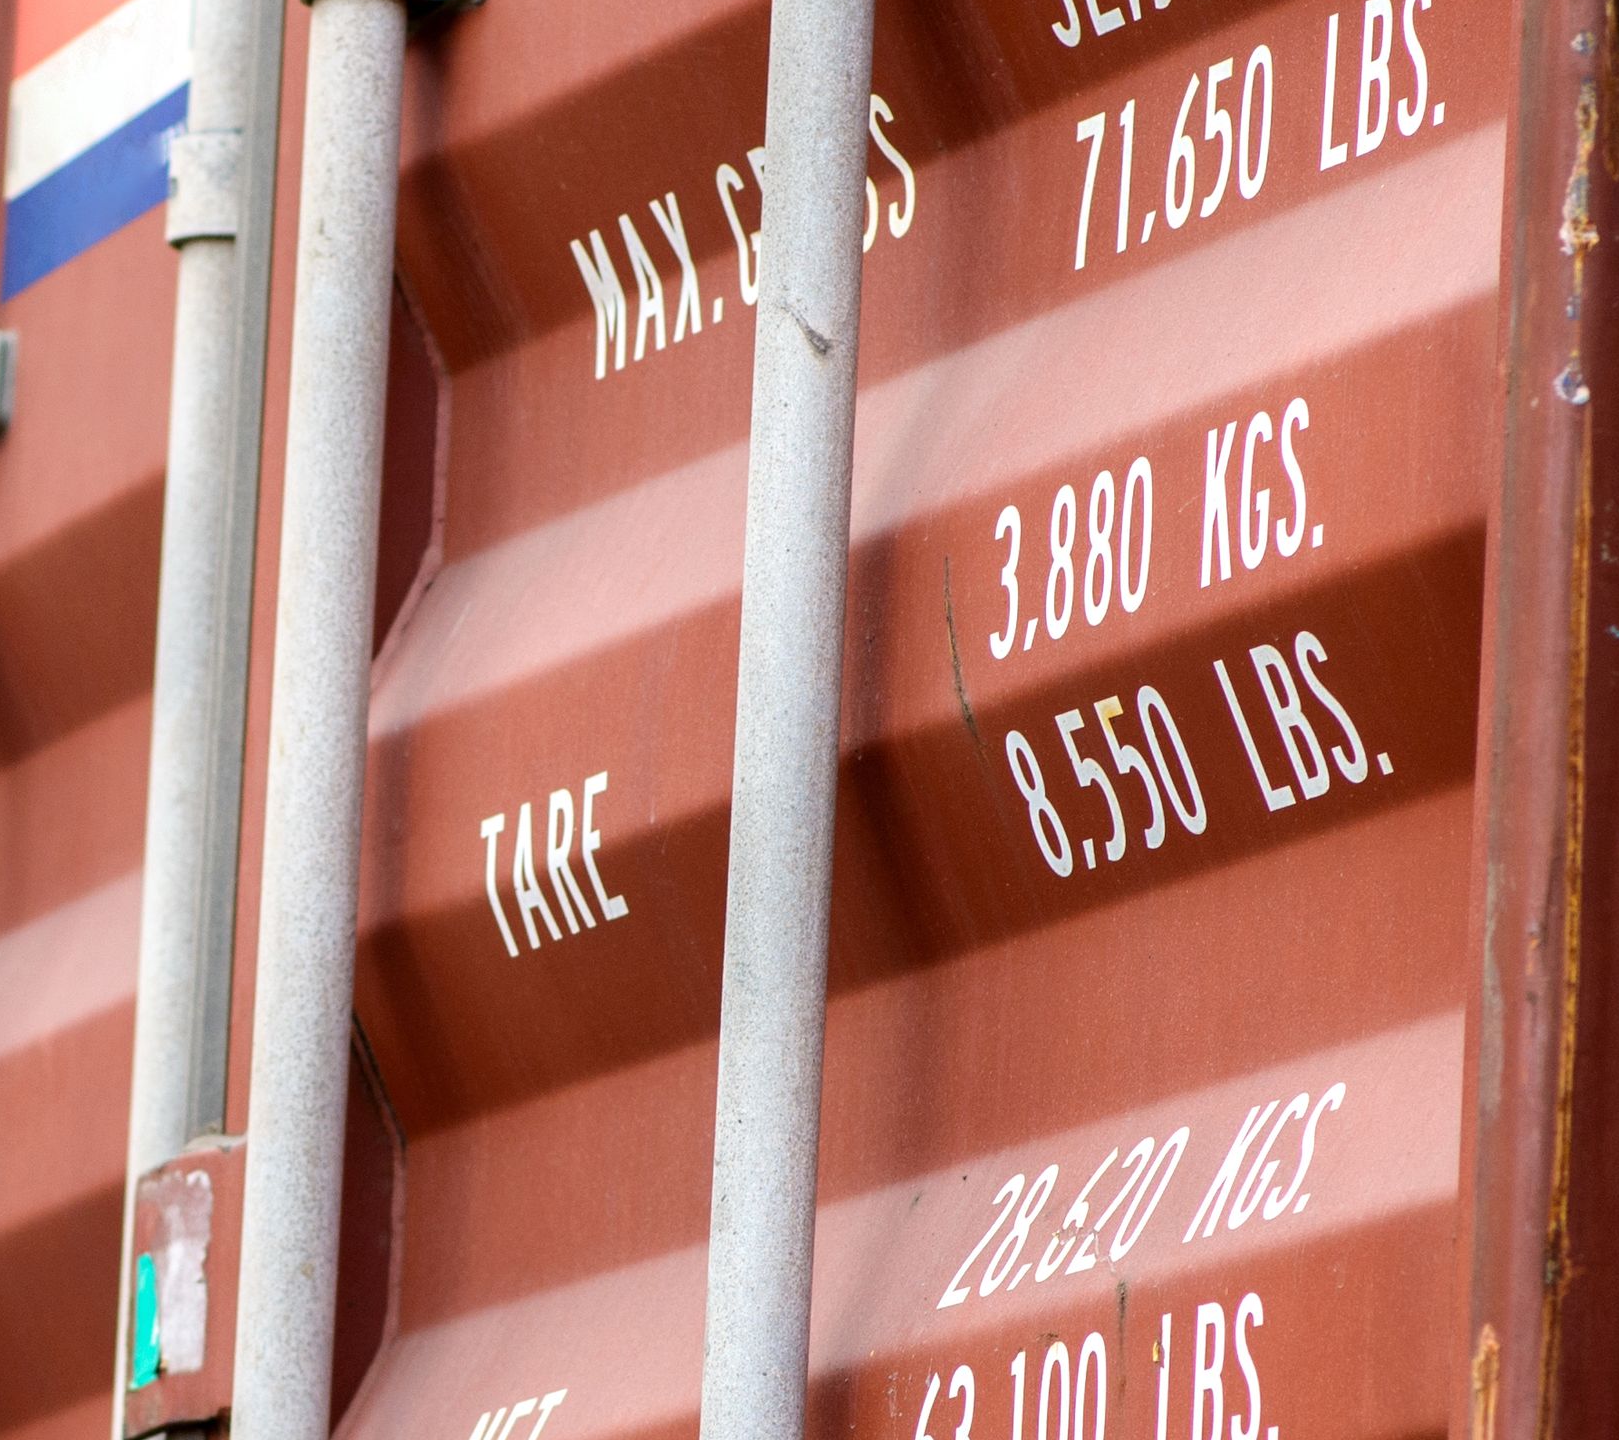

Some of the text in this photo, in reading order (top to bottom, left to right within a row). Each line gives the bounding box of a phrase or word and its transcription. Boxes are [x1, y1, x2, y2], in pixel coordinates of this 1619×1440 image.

[1074, 44, 1274, 271] 71,650
[989, 397, 1325, 660] 3,880 KGS.
[480, 770, 630, 958] TARE
[1005, 630, 1395, 878] 8,550 LBS.
[935, 1082, 1347, 1310] 28,620 KGS.
